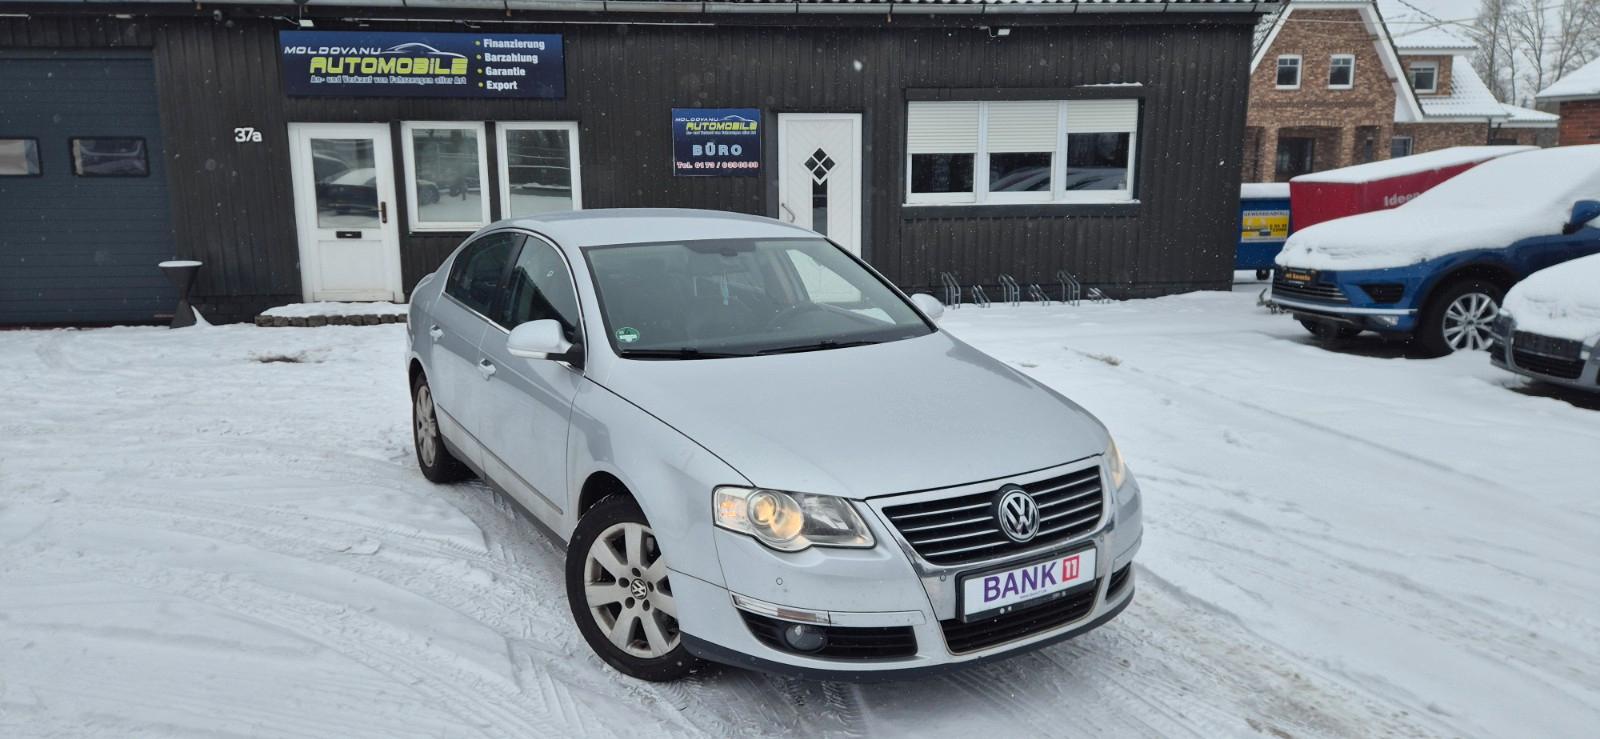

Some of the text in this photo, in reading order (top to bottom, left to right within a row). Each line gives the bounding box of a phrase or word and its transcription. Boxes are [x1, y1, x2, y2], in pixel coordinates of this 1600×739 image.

[284, 46, 382, 55] MOLDOVANU
[483, 38, 546, 51] Finanzierung
[484, 53, 539, 64] Barzahlung
[485, 66, 526, 76] Garantie
[486, 80, 518, 91] Export
[234, 127, 263, 142] 37a
[692, 142, 743, 156] BÜRO
[984, 561, 1057, 602] BANK
